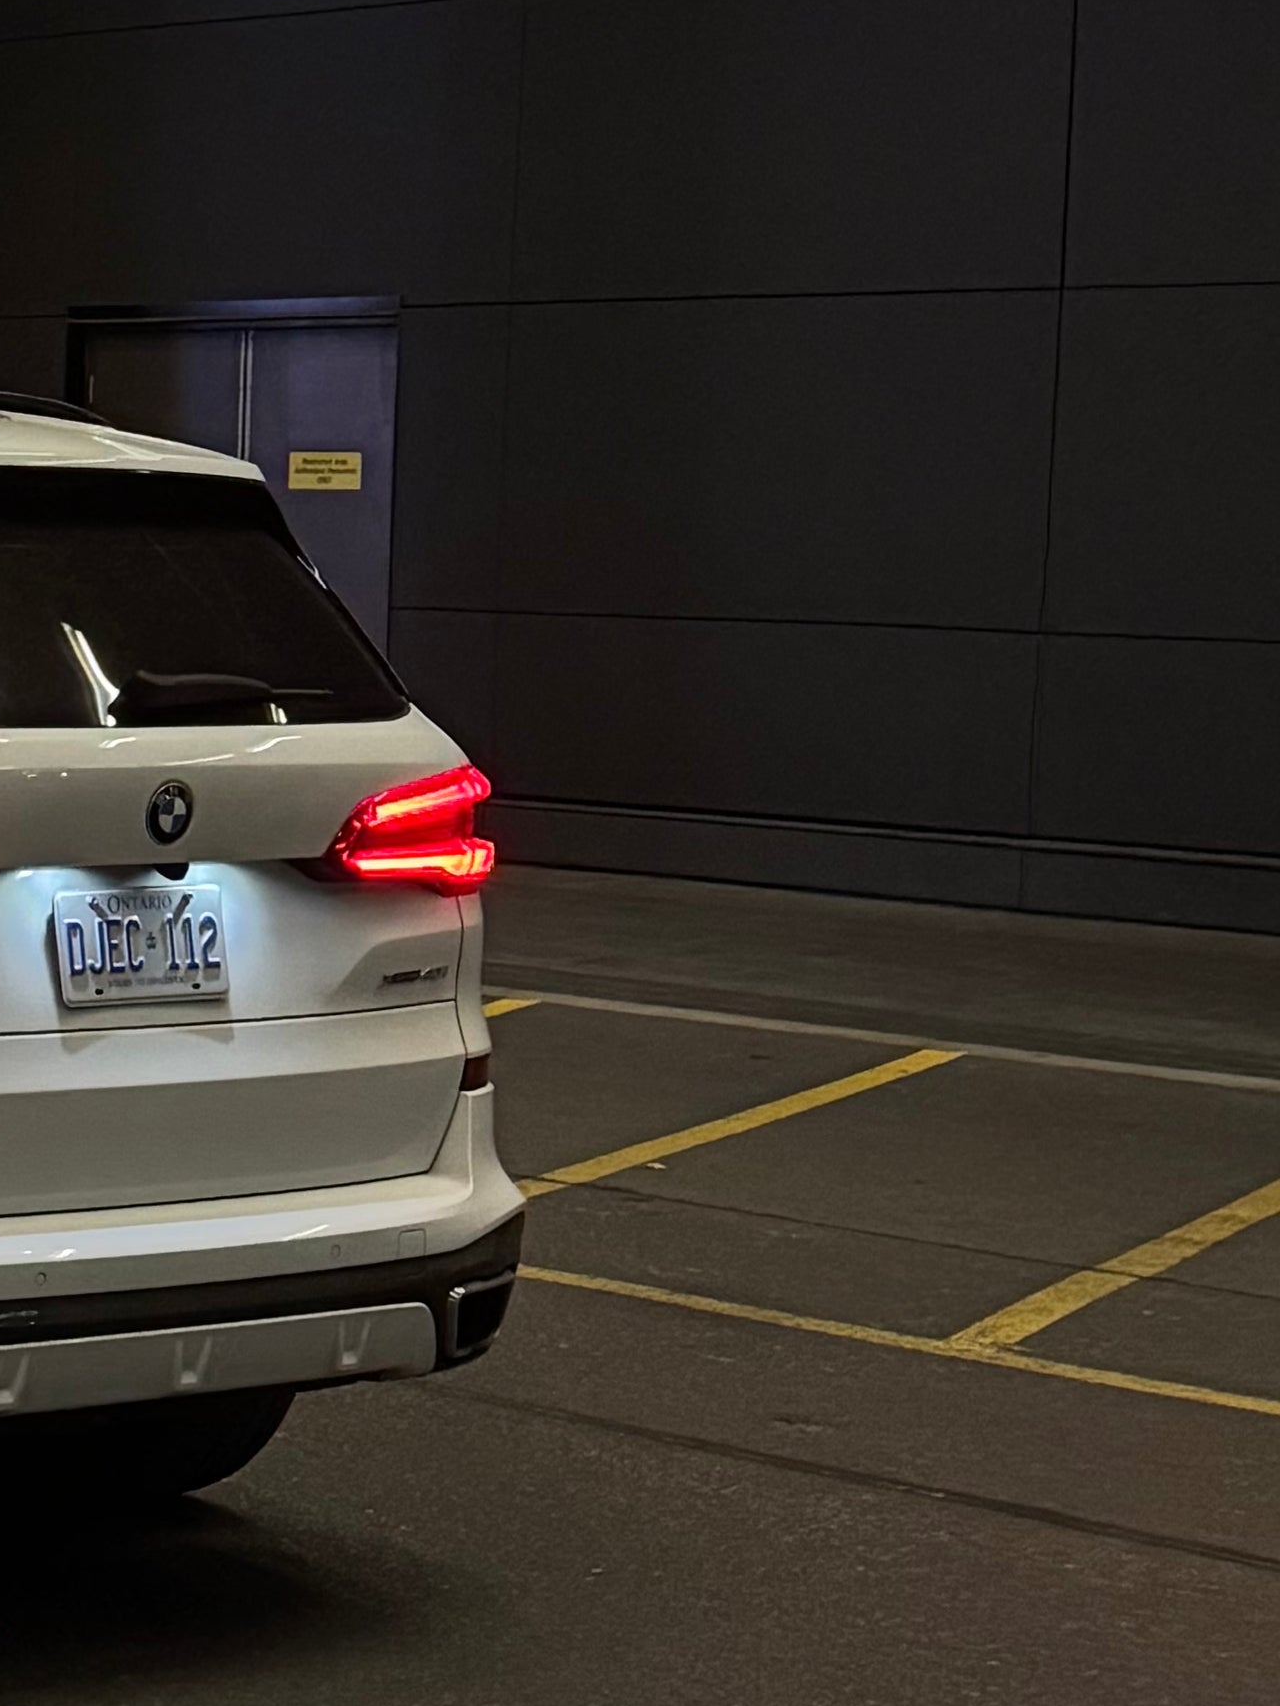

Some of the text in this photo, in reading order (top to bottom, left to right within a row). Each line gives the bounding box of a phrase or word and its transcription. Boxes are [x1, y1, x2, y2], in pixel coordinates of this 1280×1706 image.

[107, 894, 173, 913] ONTARIO
[65, 912, 222, 977] DJEC 112
